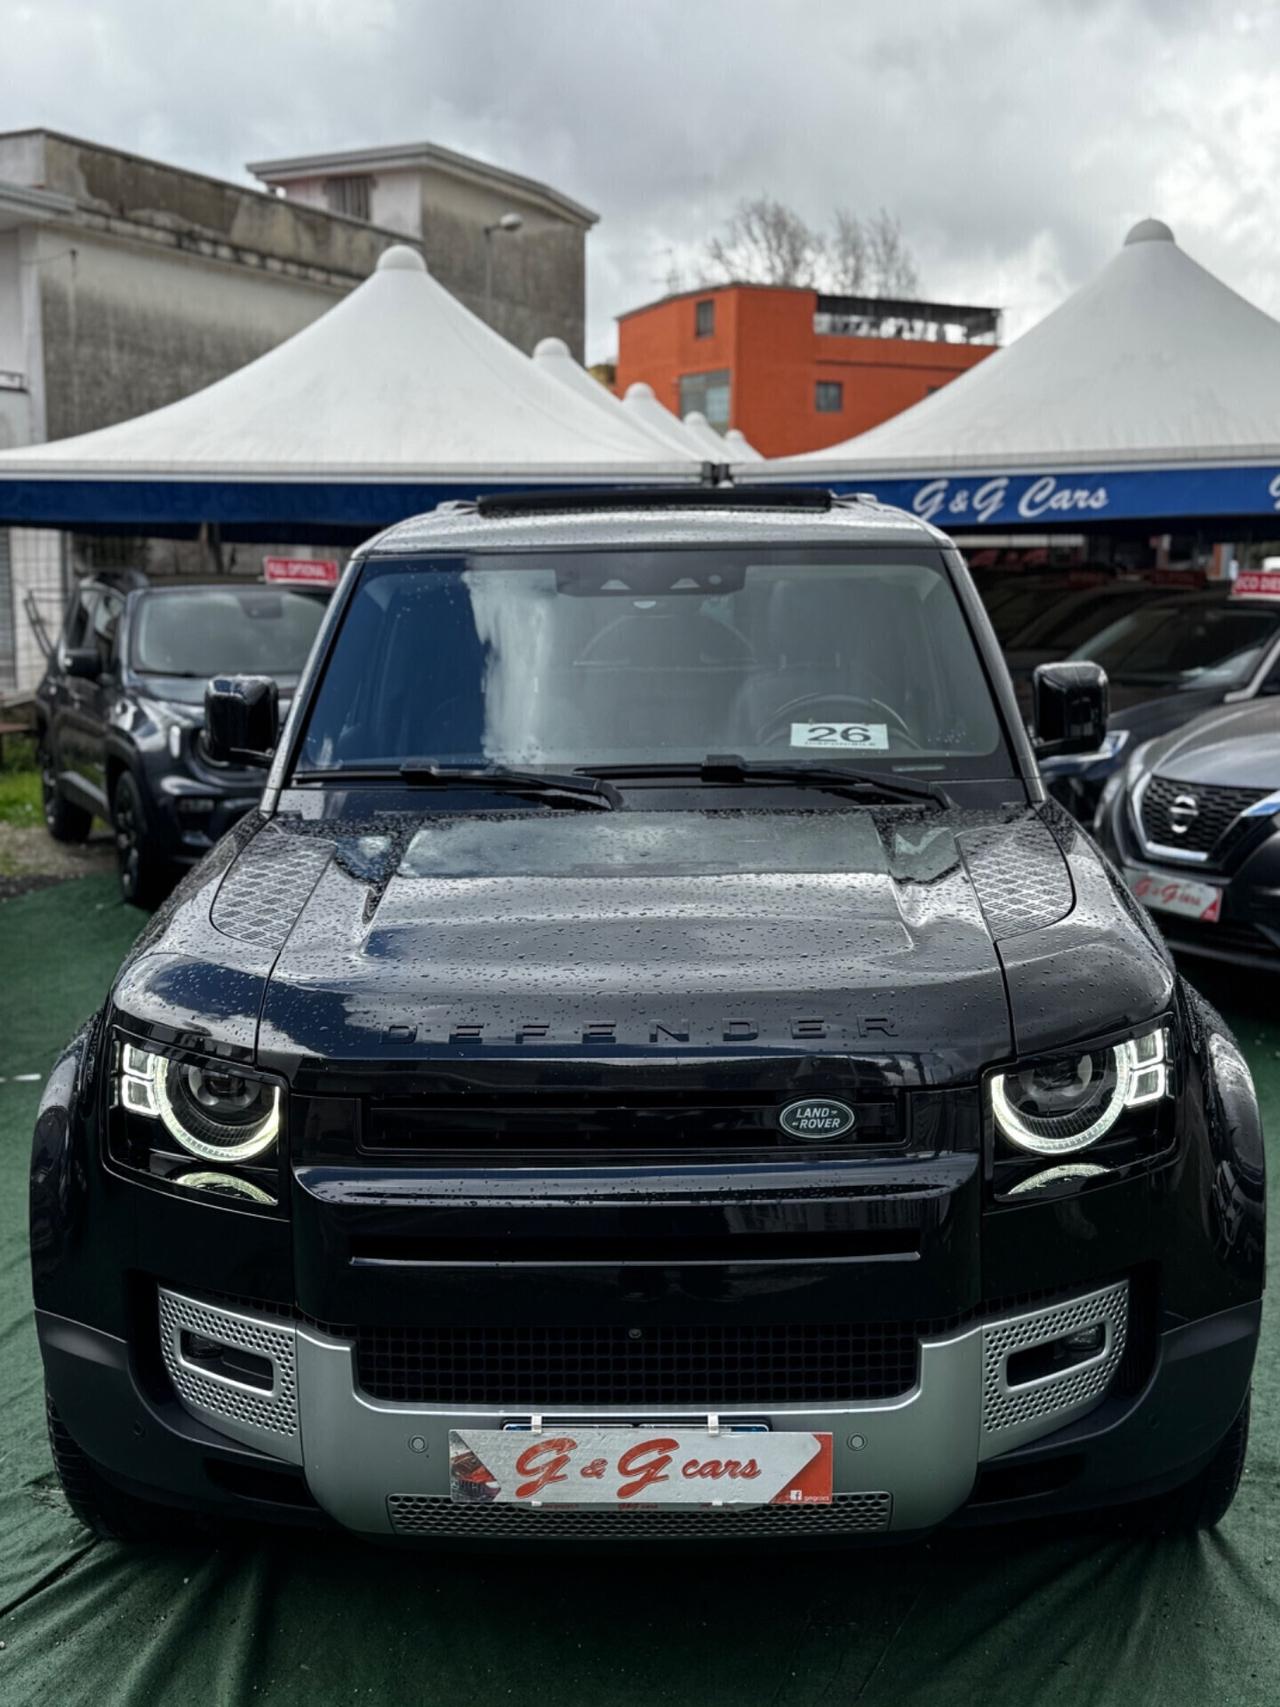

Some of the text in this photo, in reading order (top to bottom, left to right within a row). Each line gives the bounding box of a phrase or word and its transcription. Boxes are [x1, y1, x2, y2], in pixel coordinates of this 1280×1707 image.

[1018, 475, 1109, 519] Cars
[807, 726, 872, 743] 26
[379, 1015, 900, 1044] DEFENDER
[681, 1458, 762, 1480] cars
